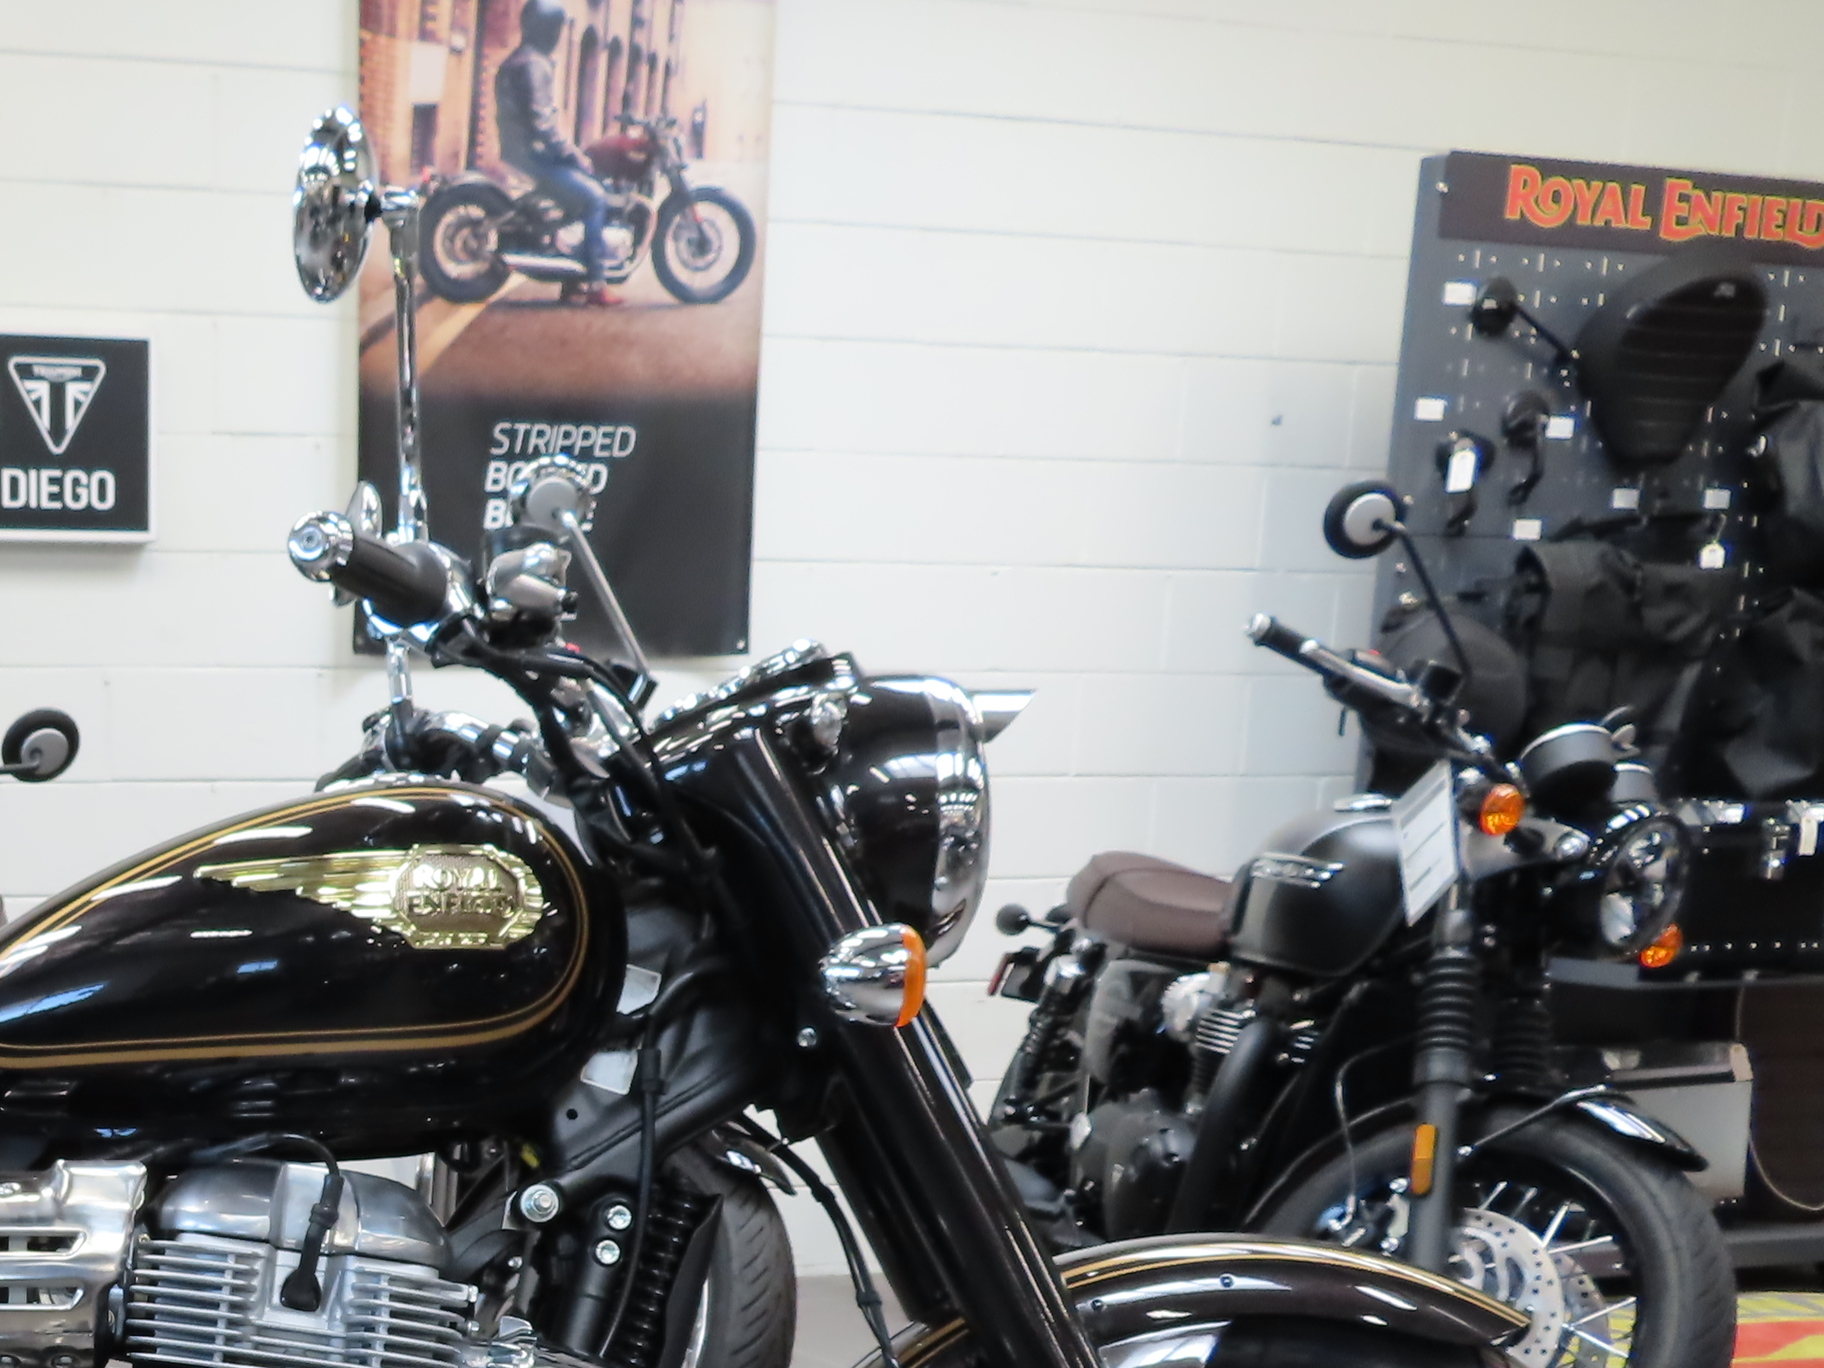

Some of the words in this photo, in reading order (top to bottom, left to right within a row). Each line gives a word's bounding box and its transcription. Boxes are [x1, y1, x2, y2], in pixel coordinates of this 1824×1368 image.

[1504, 163, 1653, 229] ROYAL
[1659, 176, 1824, 250] ENFIELD
[489, 421, 637, 459] STRIPPED
[0, 468, 117, 512] DIEGO
